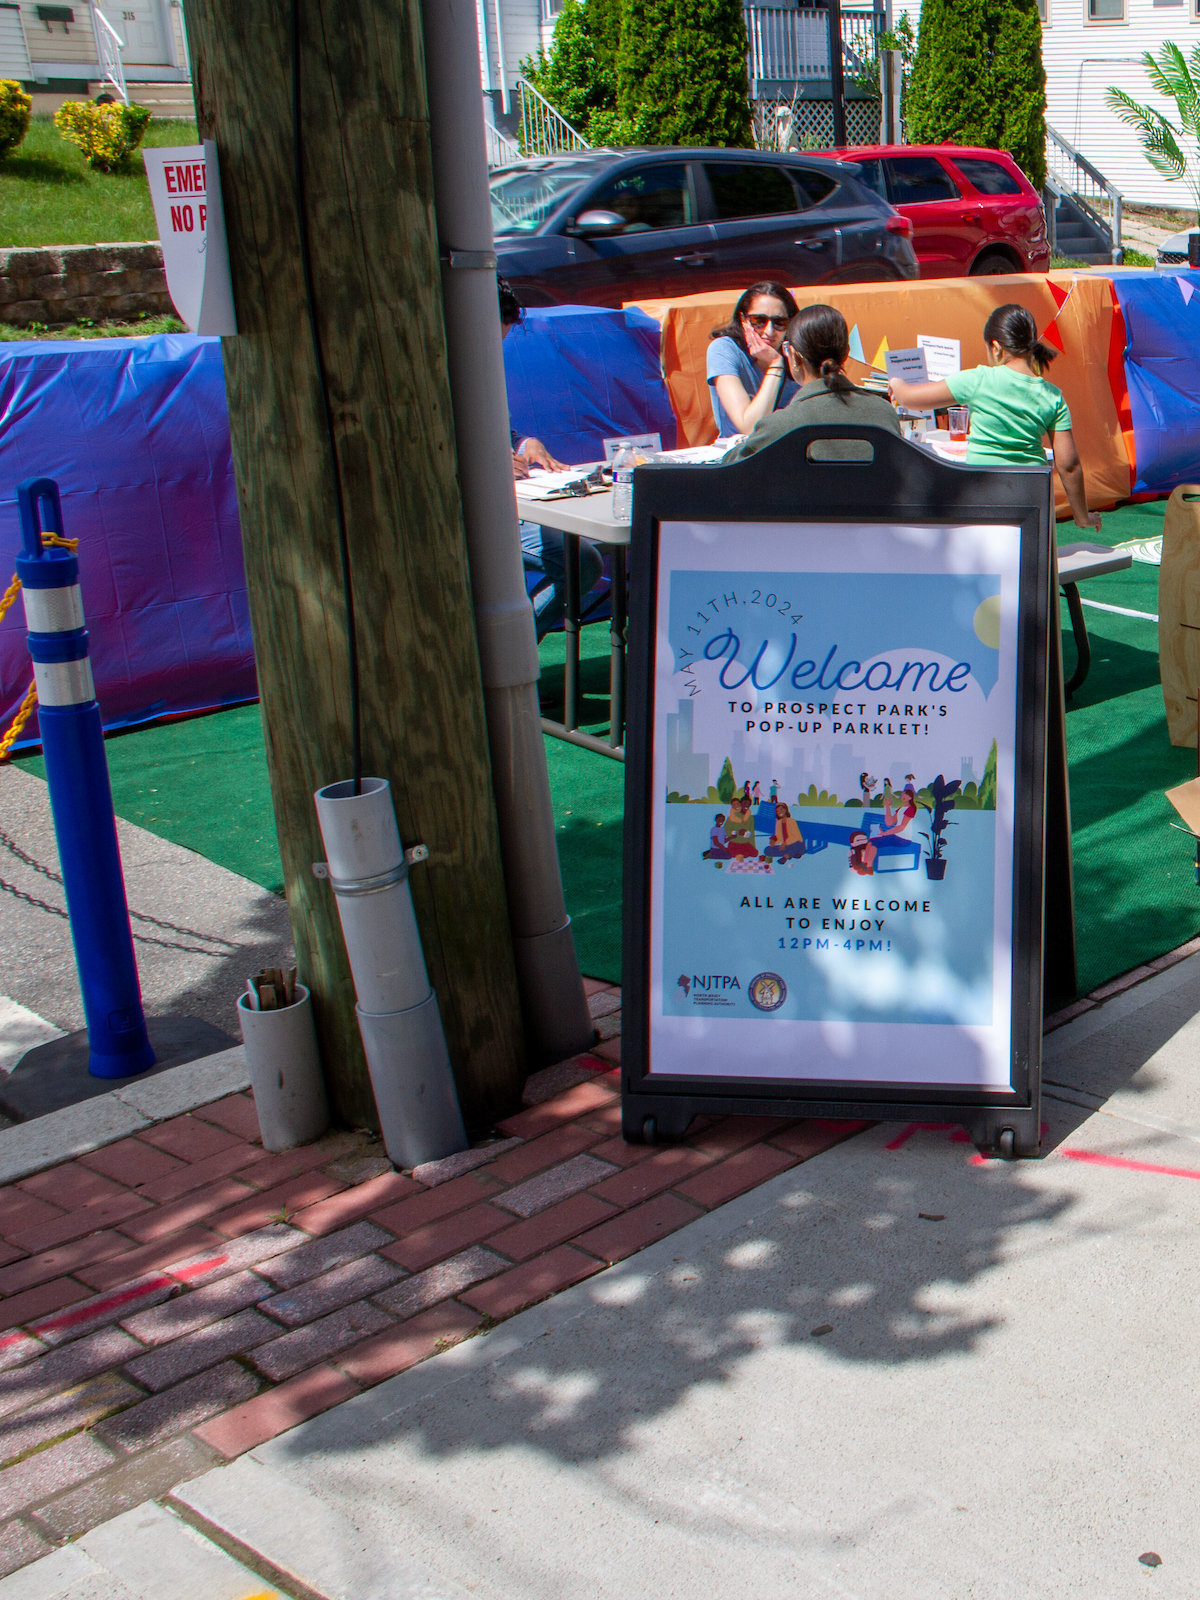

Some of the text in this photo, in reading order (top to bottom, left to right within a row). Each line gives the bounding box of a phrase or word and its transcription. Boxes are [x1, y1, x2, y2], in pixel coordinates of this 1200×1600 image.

[122, 10, 136, 21] 315
[170, 204, 194, 232] NO
[703, 627, 971, 692] Welcome
[679, 647, 702, 697] MAY
[728, 701, 948, 717] TO PROSPECT PARK'S
[746, 720, 930, 735] POP-UP PARKLET!
[740, 896, 931, 912] ALL ARE WELCOME
[786, 917, 886, 931] TO ENJOY
[777, 937, 892, 951] 12PM-4PM!
[693, 975, 741, 991] NJTPA
